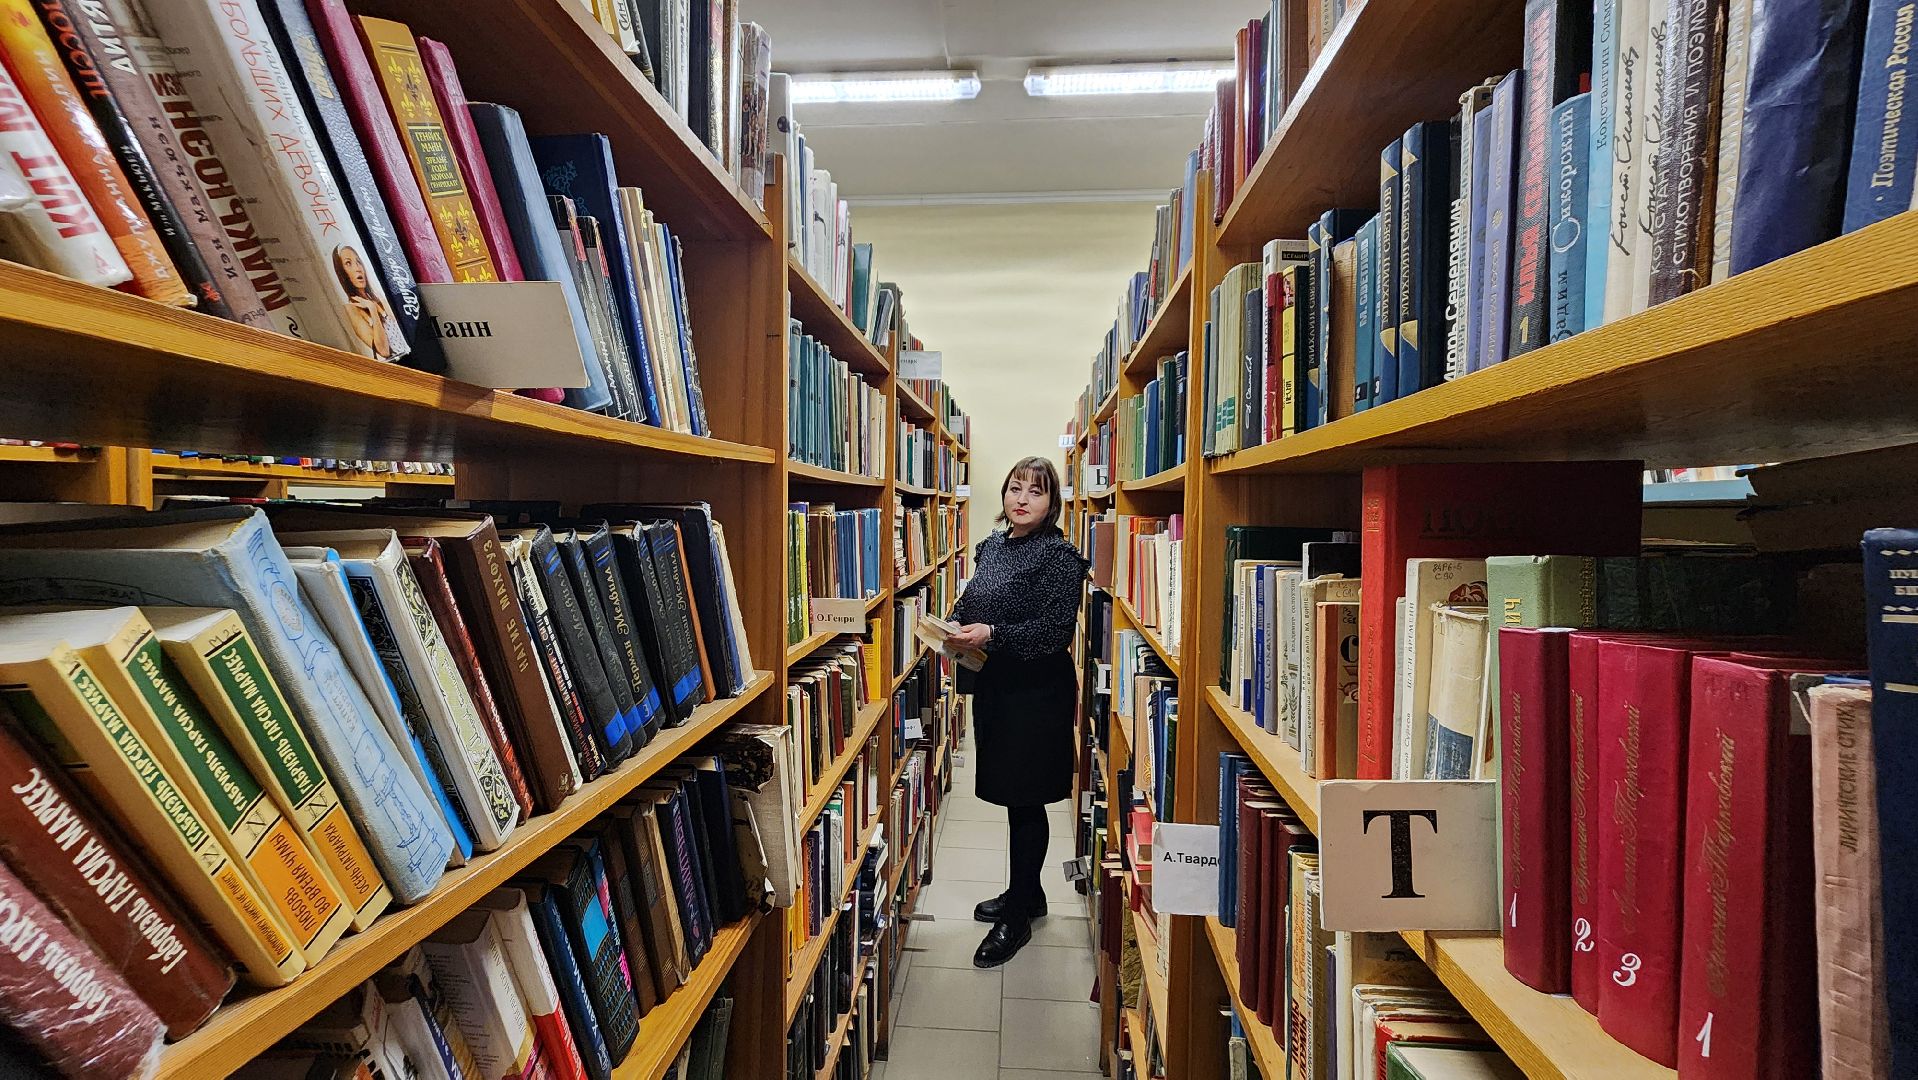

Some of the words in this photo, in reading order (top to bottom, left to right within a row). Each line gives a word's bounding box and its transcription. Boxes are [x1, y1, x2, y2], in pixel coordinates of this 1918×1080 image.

[1884, 0, 1916, 71] Россия
[217, 0, 290, 127] БОЛЬШИХ
[269, 124, 340, 238] ДЕВОЧЕК
[1522, 7, 1549, 219] СЕЛЬВИНСКИЙ
[1595, 46, 1610, 150] Константин
[1870, 67, 1906, 191] Поэтическая
[8, 133, 100, 248] КИТ
[163, 91, 292, 314] МАКЬЮЭН
[1550, 105, 1579, 253] Сикорский
[1649, 129, 1673, 274] КОНСТАНТИН
[1671, 103, 1699, 265] СТИХОТВОРЕНИЯ
[1686, 80, 1700, 99] И
[1383, 186, 1393, 252] СВЕТЛОВ
[1401, 172, 1410, 240] СВЕТЛОВ
[1307, 257, 1315, 309] СВЕТЛОВ
[1381, 255, 1391, 322] МИХАИЛ
[1400, 243, 1410, 315] МИХАИЛ
[1445, 197, 1463, 320] Северянин
[1517, 223, 1538, 305] ИЛЬЯ
[430, 314, 493, 338] анн
[1307, 312, 1315, 364] МИХАИЛ
[1442, 321, 1459, 381] Игорь
[1520, 316, 1529, 344] 1
[480, 538, 512, 610] МАХФУЗ
[595, 564, 633, 637] Мелвилл
[667, 550, 689, 611] Мелвилл
[222, 645, 259, 700] МАРКЕС
[503, 617, 532, 672] НАГИБ
[75, 674, 123, 734] МАРКЕС
[134, 649, 179, 706] МАРКЕС
[169, 702, 211, 754] ГАРСИА
[250, 694, 285, 742] ГАРСИА
[114, 728, 159, 782] ГАРСИА
[200, 748, 251, 812] ГАБРИЭЛЬ
[273, 736, 315, 795] ГАБРИЭЛЬ
[10, 765, 89, 852] МАРКЕС
[149, 778, 202, 844] ГАБРИЭЛЬ
[1838, 748, 1858, 852] ЛИРИЧЕСКИЕ
[68, 835, 138, 913] ГАРСИА
[267, 830, 300, 867] ЧУМЫ
[321, 819, 359, 871] ПАТРИАРХА
[1363, 810, 1438, 899] Т
[280, 885, 318, 931] ЛЮБОВЬ
[288, 861, 323, 900] ВРЕМЯ
[312, 894, 332, 914] ВО
[346, 865, 372, 895] ОСЕНЬ
[1508, 892, 1518, 928] 1
[123, 893, 194, 974] Габриэль
[1574, 917, 1595, 953] 2
[1612, 952, 1642, 987] 3
[1298, 1011, 1307, 1077] ПОЭМЫ
[1695, 1011, 1714, 1058] 1
